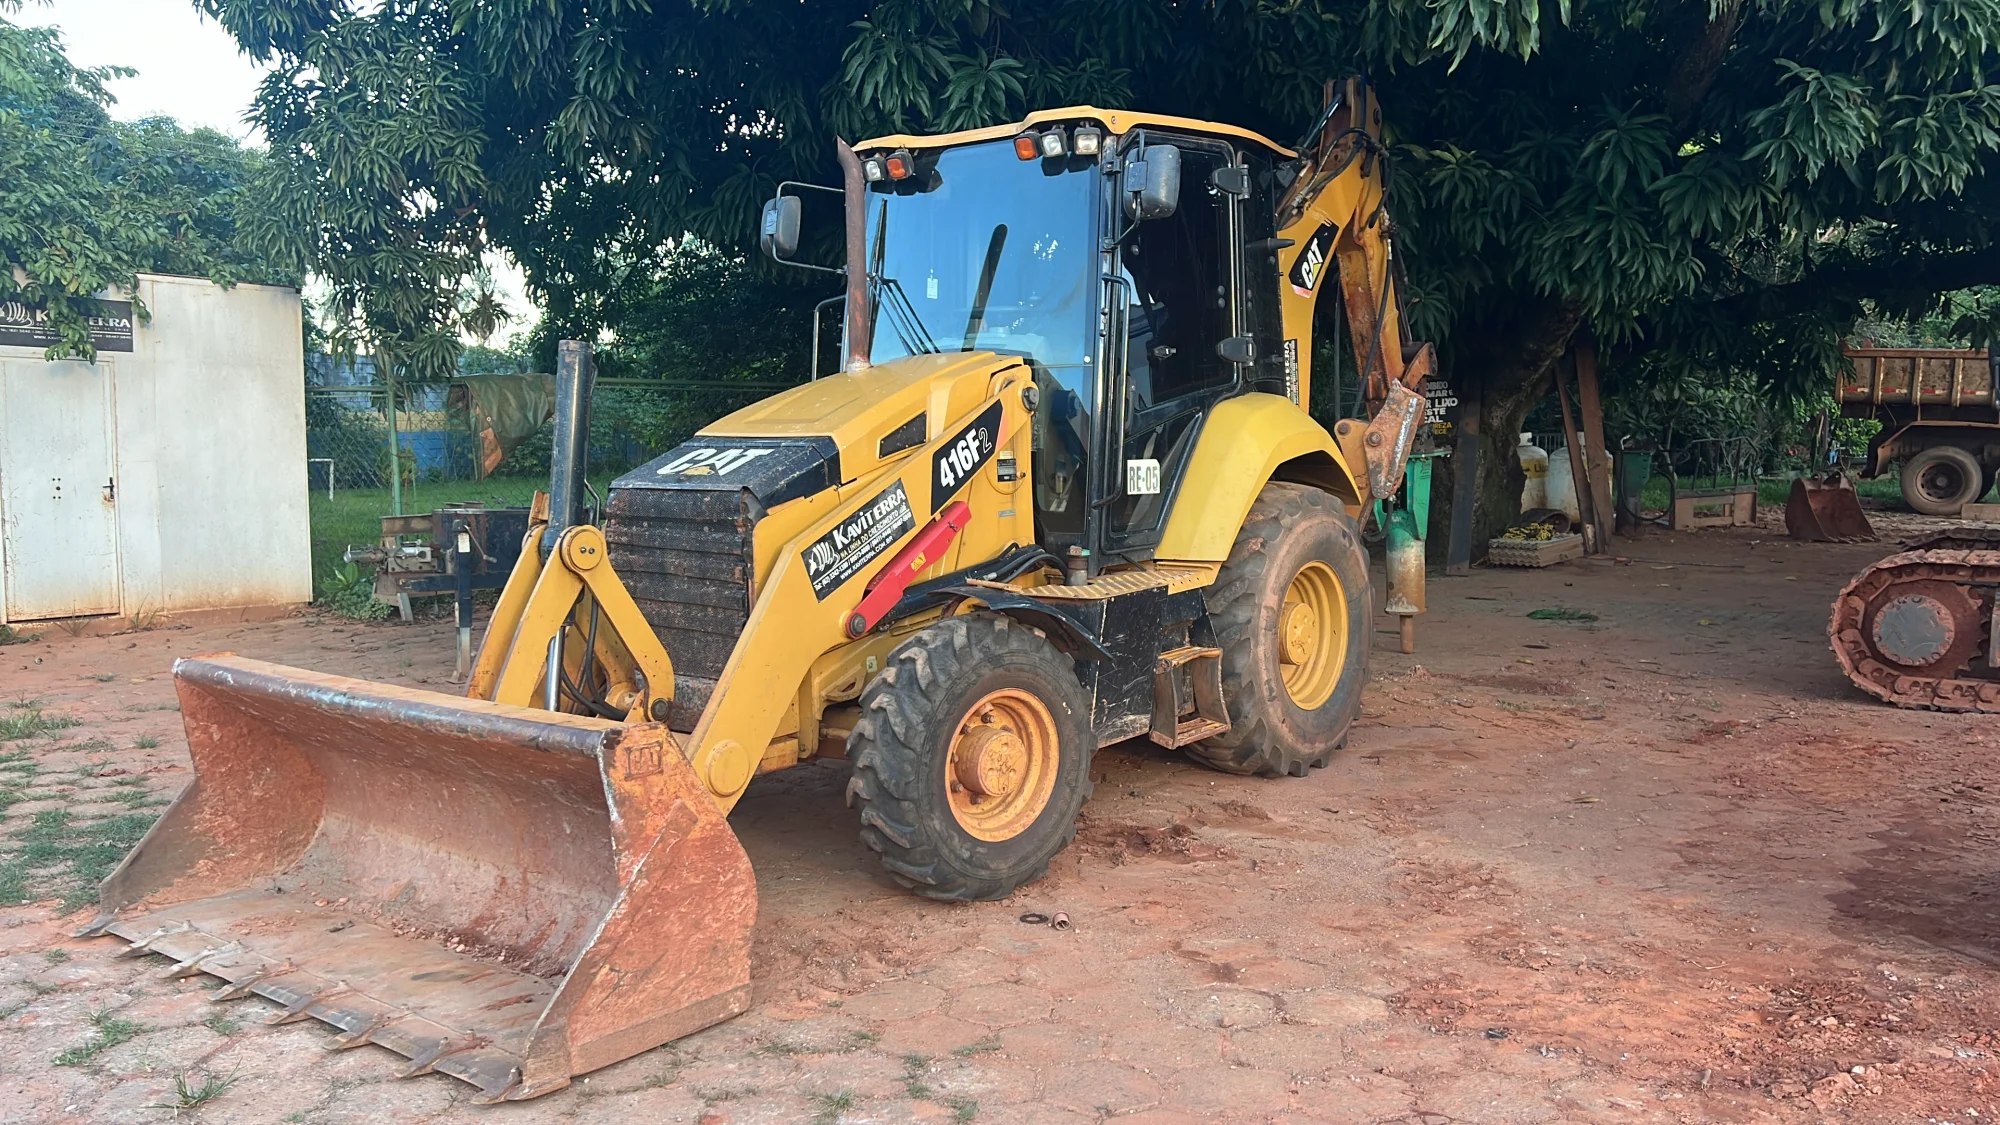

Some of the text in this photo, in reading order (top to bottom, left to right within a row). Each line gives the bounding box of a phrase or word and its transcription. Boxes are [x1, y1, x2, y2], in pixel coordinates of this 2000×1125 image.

[1301, 237, 1323, 289] CAT
[1435, 398, 1458, 408] LIXO
[656, 448, 775, 476] CAT
[1129, 466, 1159, 492] RE-05
[861, 534, 869, 543] DO
